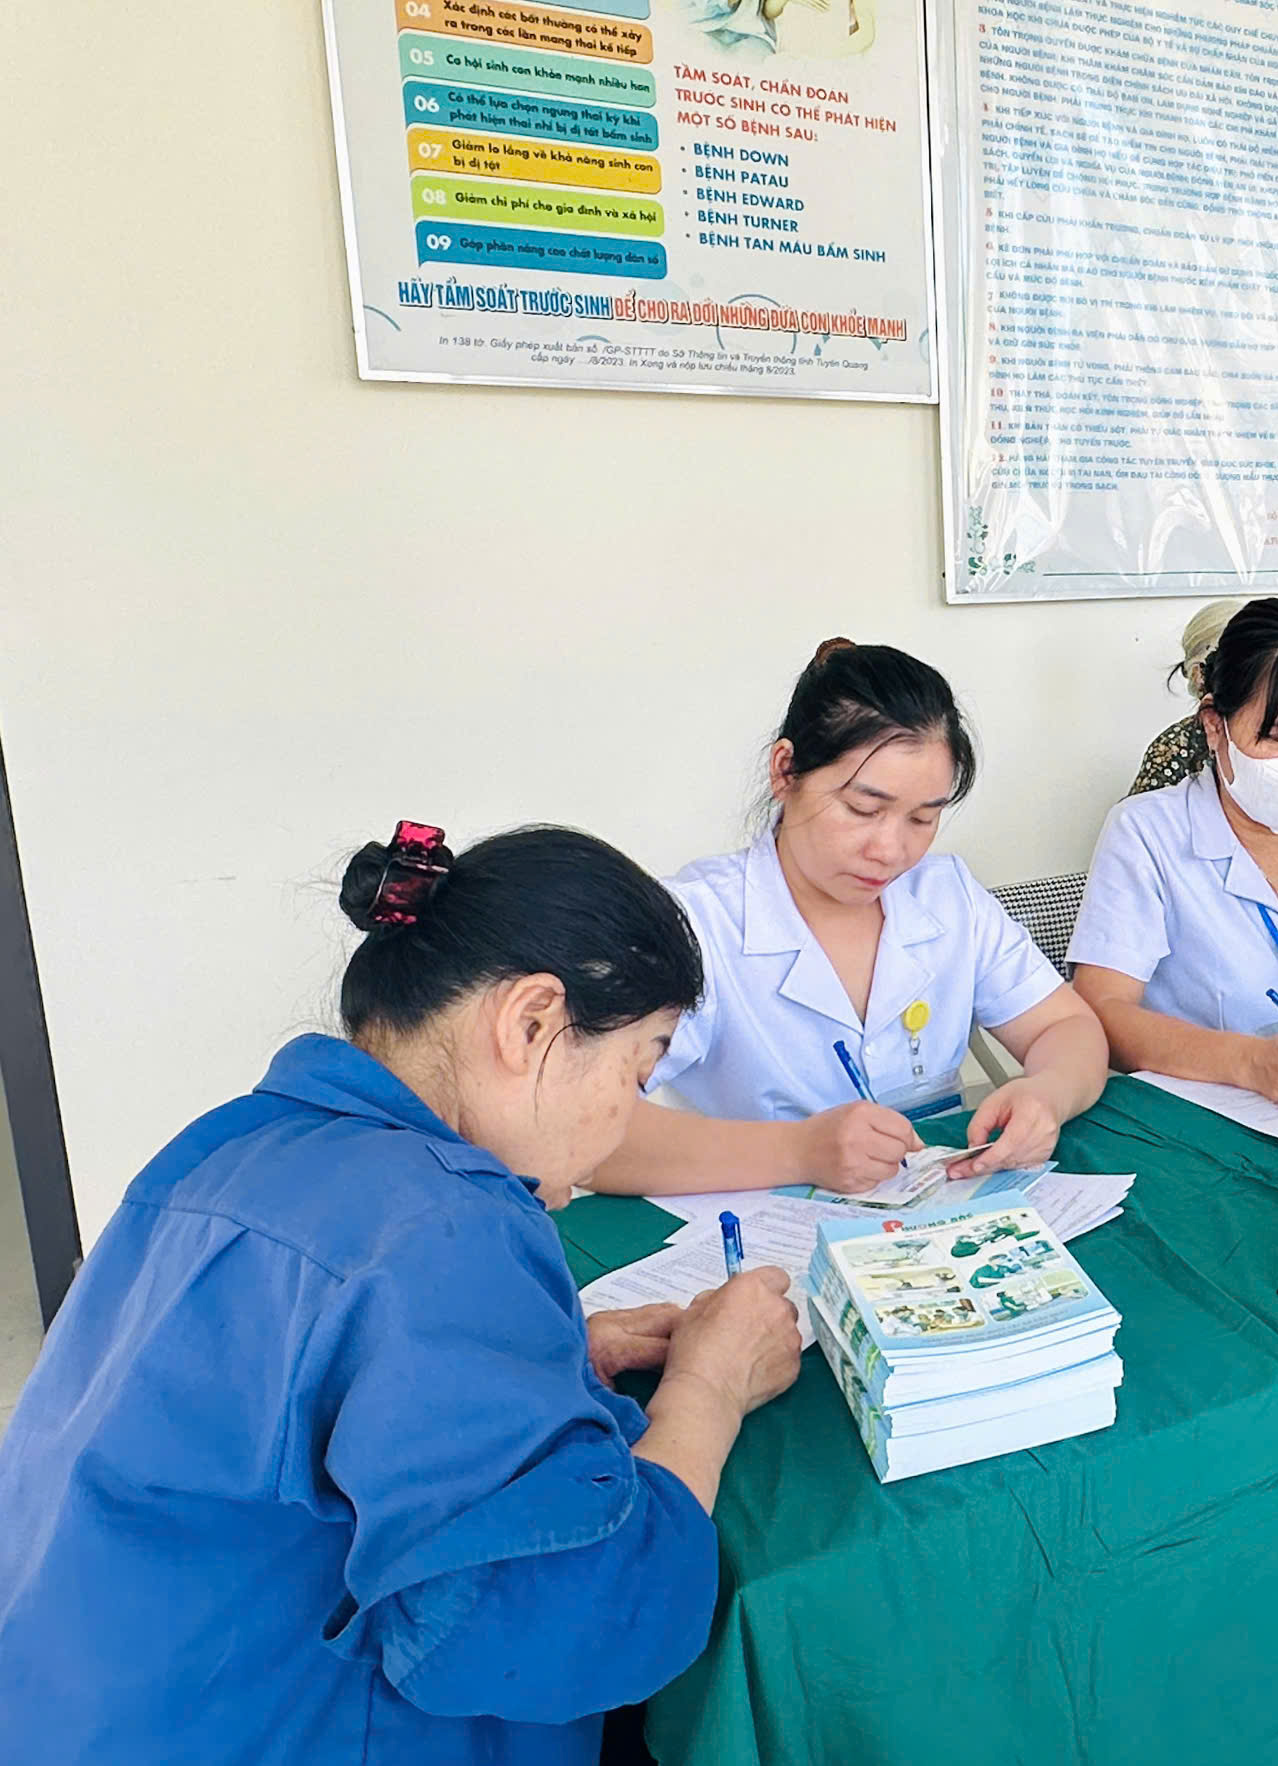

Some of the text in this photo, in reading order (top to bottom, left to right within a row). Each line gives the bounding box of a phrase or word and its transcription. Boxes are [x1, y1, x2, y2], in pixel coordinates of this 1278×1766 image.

[405, 1, 431, 18] 04
[444, 0, 465, 13] Xác
[469, 4, 495, 18] định
[499, 9, 517, 21] các
[585, 23, 598, 34] có
[444, 19, 457, 29] ra
[461, 20, 493, 36] trong
[496, 24, 515, 37] các
[540, 33, 572, 48] mang
[575, 36, 597, 50] thai
[409, 48, 434, 66] 05
[465, 55, 482, 70] hội
[486, 58, 509, 73] sinh
[512, 64, 531, 76] con
[565, 70, 595, 87] mạnh
[673, 62, 706, 82] TẦM
[414, 95, 440, 113] 06
[512, 98, 539, 115] chọn
[581, 106, 602, 122] thai
[623, 110, 640, 126] khi
[730, 96, 766, 113] SINH
[864, 116, 897, 133] HIỆN
[480, 111, 506, 127] hiện
[509, 114, 531, 129] thai
[535, 117, 553, 132] nhi
[556, 119, 567, 136] bị
[570, 122, 581, 137] dị
[630, 129, 652, 143] sinh
[677, 111, 818, 142] MỘT SỐ BỆNH SAU:
[418, 142, 442, 158] 07
[454, 156, 500, 171] bị dị tật
[488, 143, 500, 155] lo
[608, 156, 631, 169] sinh
[634, 160, 653, 172] con
[694, 142, 789, 167] BỆNH DOWN
[695, 164, 789, 188] BỆNH PATAU
[491, 194, 508, 207] chi
[532, 199, 552, 212] cho
[556, 203, 573, 216] gia
[640, 209, 656, 222] hội
[696, 186, 804, 212] BỆNH EDWARD
[698, 209, 799, 233] BỆNH TURNER
[426, 233, 452, 250] 09
[699, 231, 740, 249] BỆNH
[744, 236, 774, 252] TAN
[853, 248, 886, 263] SINH
[398, 278, 430, 305] HÃY
[476, 283, 516, 310] SOÁT
[575, 294, 611, 318] SINH
[638, 298, 666, 320] CHO
[671, 302, 689, 322] RA
[720, 302, 767, 327] NHỮNG
[801, 312, 828, 333] CON
[867, 317, 904, 343] MẠNH
